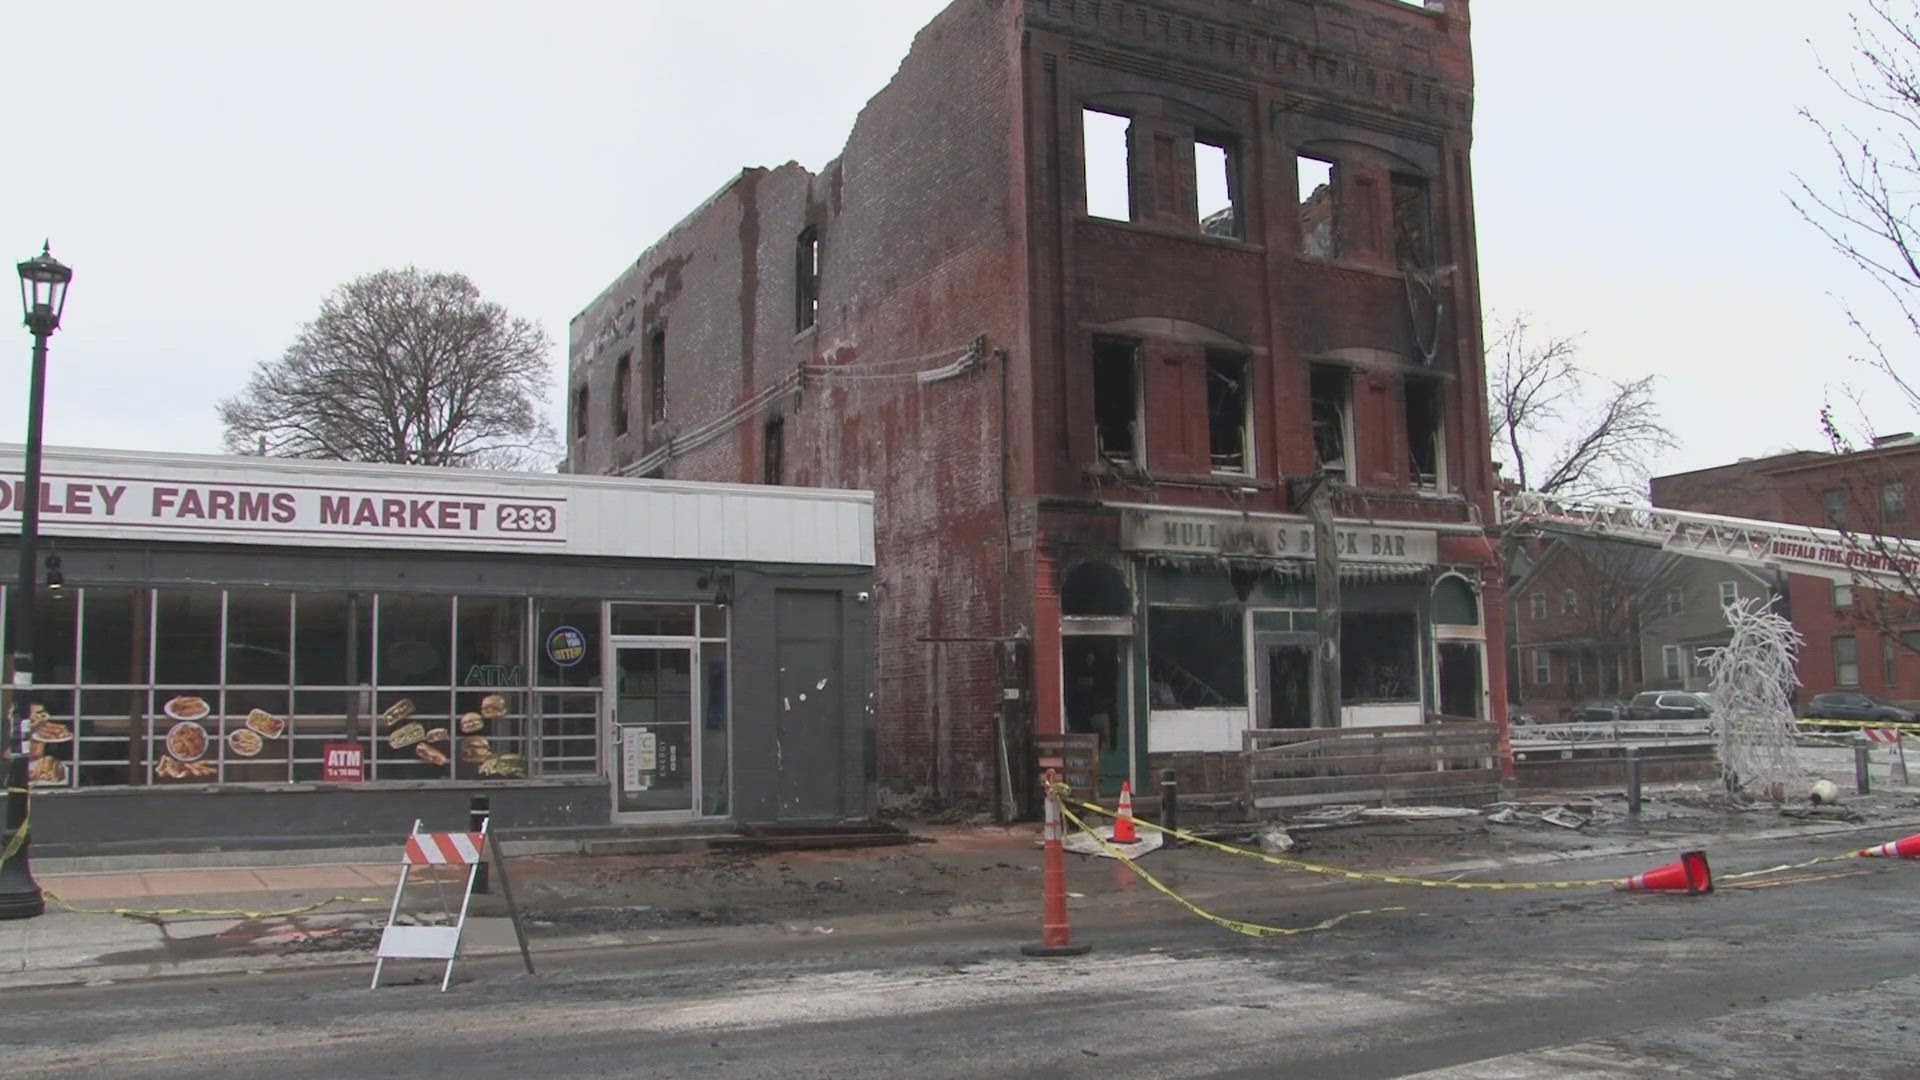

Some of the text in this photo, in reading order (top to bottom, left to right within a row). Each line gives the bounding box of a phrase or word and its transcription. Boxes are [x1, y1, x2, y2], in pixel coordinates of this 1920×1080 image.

[152, 487, 296, 523] FARMS
[319, 495, 486, 530] MARKET
[500, 507, 552, 531] 233
[1371, 534, 1405, 556] BAR
[1772, 541, 1816, 559] BUFFALO
[1819, 547, 1843, 564] FIRE
[464, 664, 521, 686] ATM
[328, 750, 360, 766] ATM
[627, 734, 635, 785] ESSENTIAL
